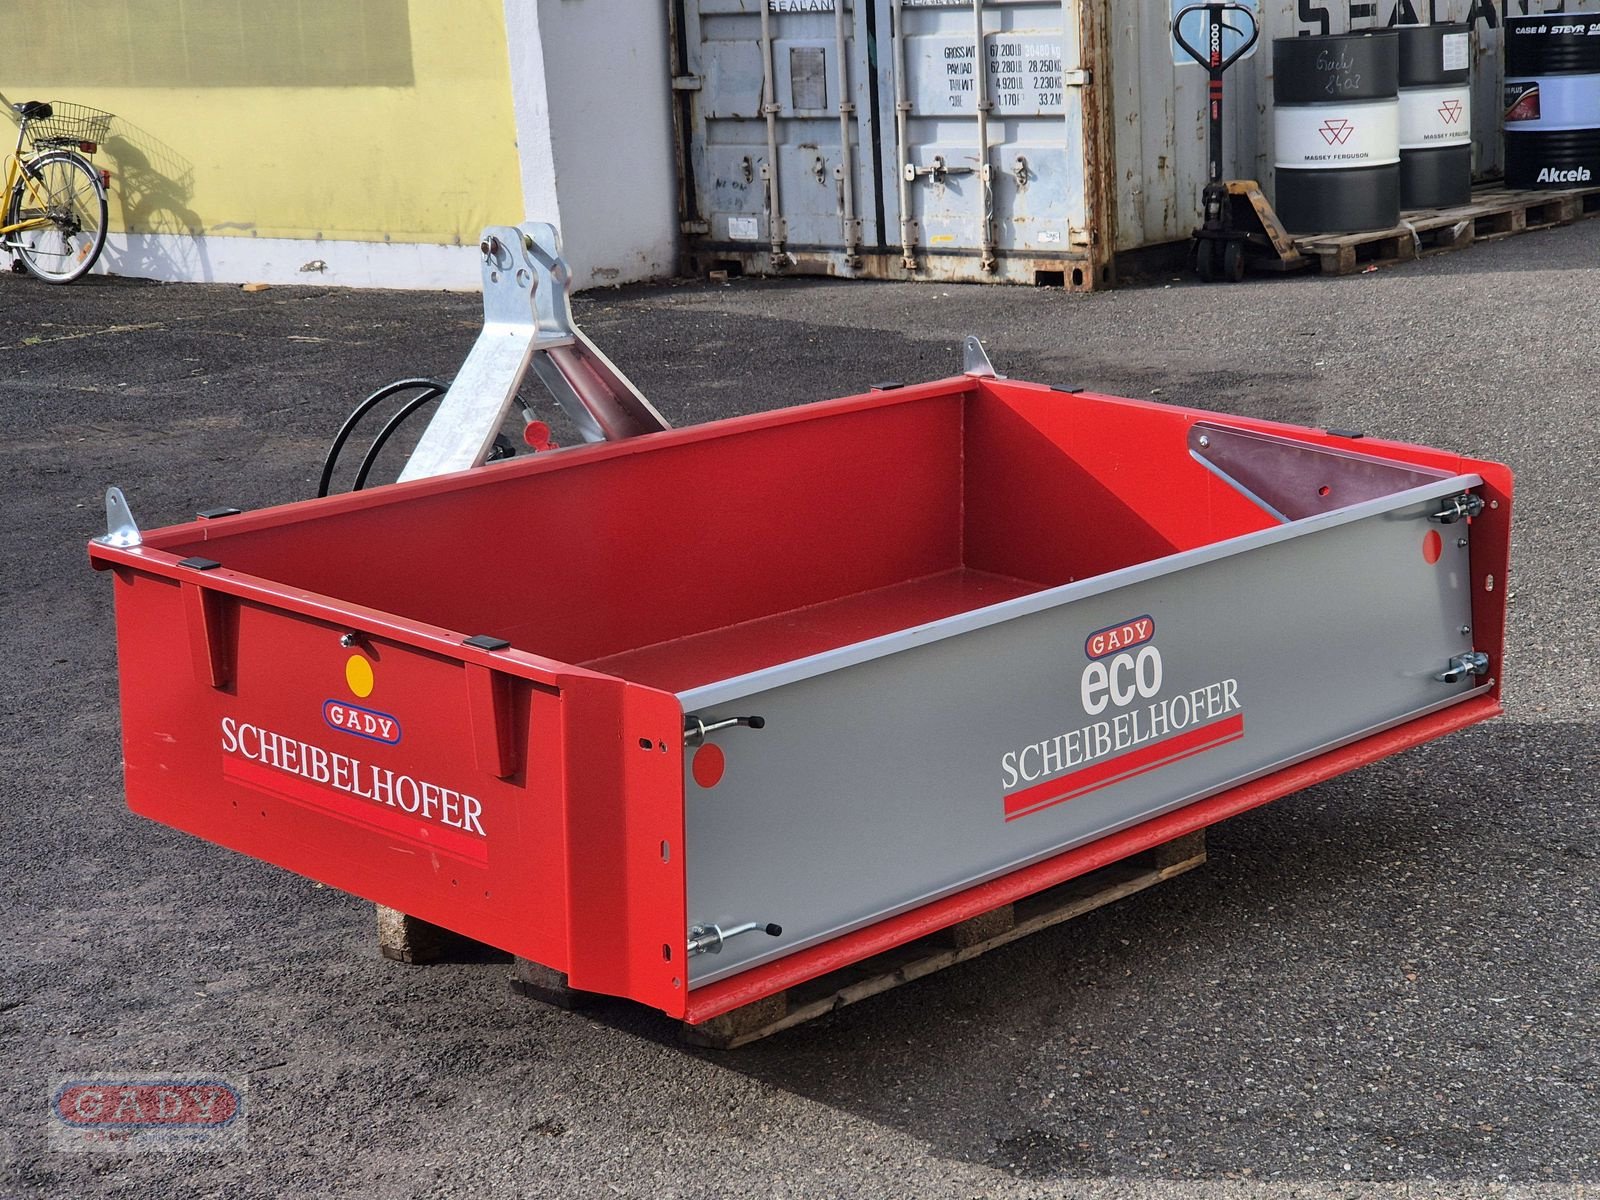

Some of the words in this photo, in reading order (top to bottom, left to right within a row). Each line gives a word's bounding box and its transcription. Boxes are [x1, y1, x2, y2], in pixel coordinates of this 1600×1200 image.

[768, 0, 835, 12] SEALAN
[1211, 24, 1219, 67] TM2000
[1551, 25, 1585, 34] STEYR
[1334, 152, 1369, 160] FERGUSON
[1537, 167, 1591, 183] Akcela
[1092, 620, 1149, 655] GADY
[1081, 645, 1163, 716] eco
[330, 705, 393, 738] GADY
[1001, 678, 1242, 790] SCHEIBELHOFER
[221, 716, 487, 836] SCHEIBELHOFER
